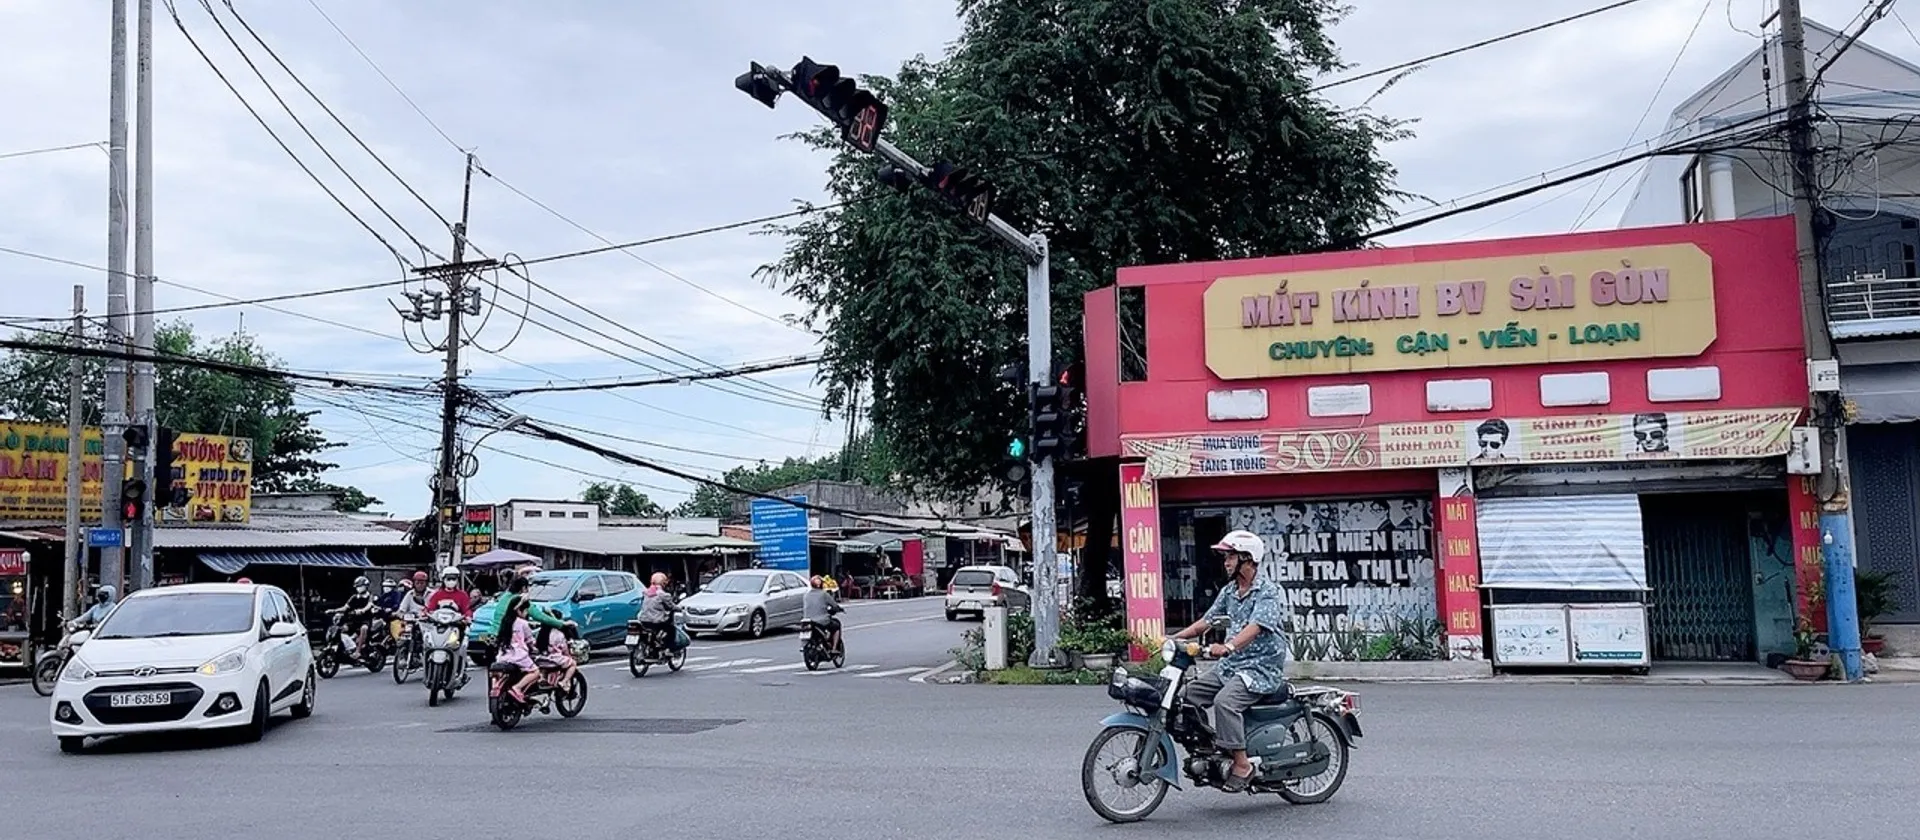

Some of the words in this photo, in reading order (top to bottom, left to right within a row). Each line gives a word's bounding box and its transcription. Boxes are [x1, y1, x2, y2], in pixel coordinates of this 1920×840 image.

[1241, 281, 1319, 328] MẮT
[1332, 279, 1420, 322] KÍNH
[1436, 280, 1486, 316] BV
[1509, 265, 1576, 311] SÀI
[1591, 260, 1671, 307] GÒN
[1269, 336, 1374, 361] CHUYÊN:
[1397, 331, 1448, 356] CẬN
[1479, 321, 1538, 350] VIỄN
[1569, 322, 1641, 347] LOẠN
[0, 427, 19, 451] Ò
[25, 432, 70, 453] BÁN
[1391, 424, 1428, 436] KÍNH
[1203, 437, 1227, 450] MUA
[1275, 432, 1376, 469] 50%
[1125, 476, 1154, 509] KÍNH
[1129, 520, 1154, 559] CẬN
[1448, 535, 1471, 557] KÍNH
[1129, 563, 1159, 599] VIỄN
[1308, 560, 1349, 581] TRA
[1357, 559, 1392, 584] THỊ
[1448, 571, 1476, 592] HÀNG
[1316, 583, 1371, 607] CHÍNH
[1293, 609, 1330, 632] BÁN
[1452, 608, 1476, 633] HIỆU
